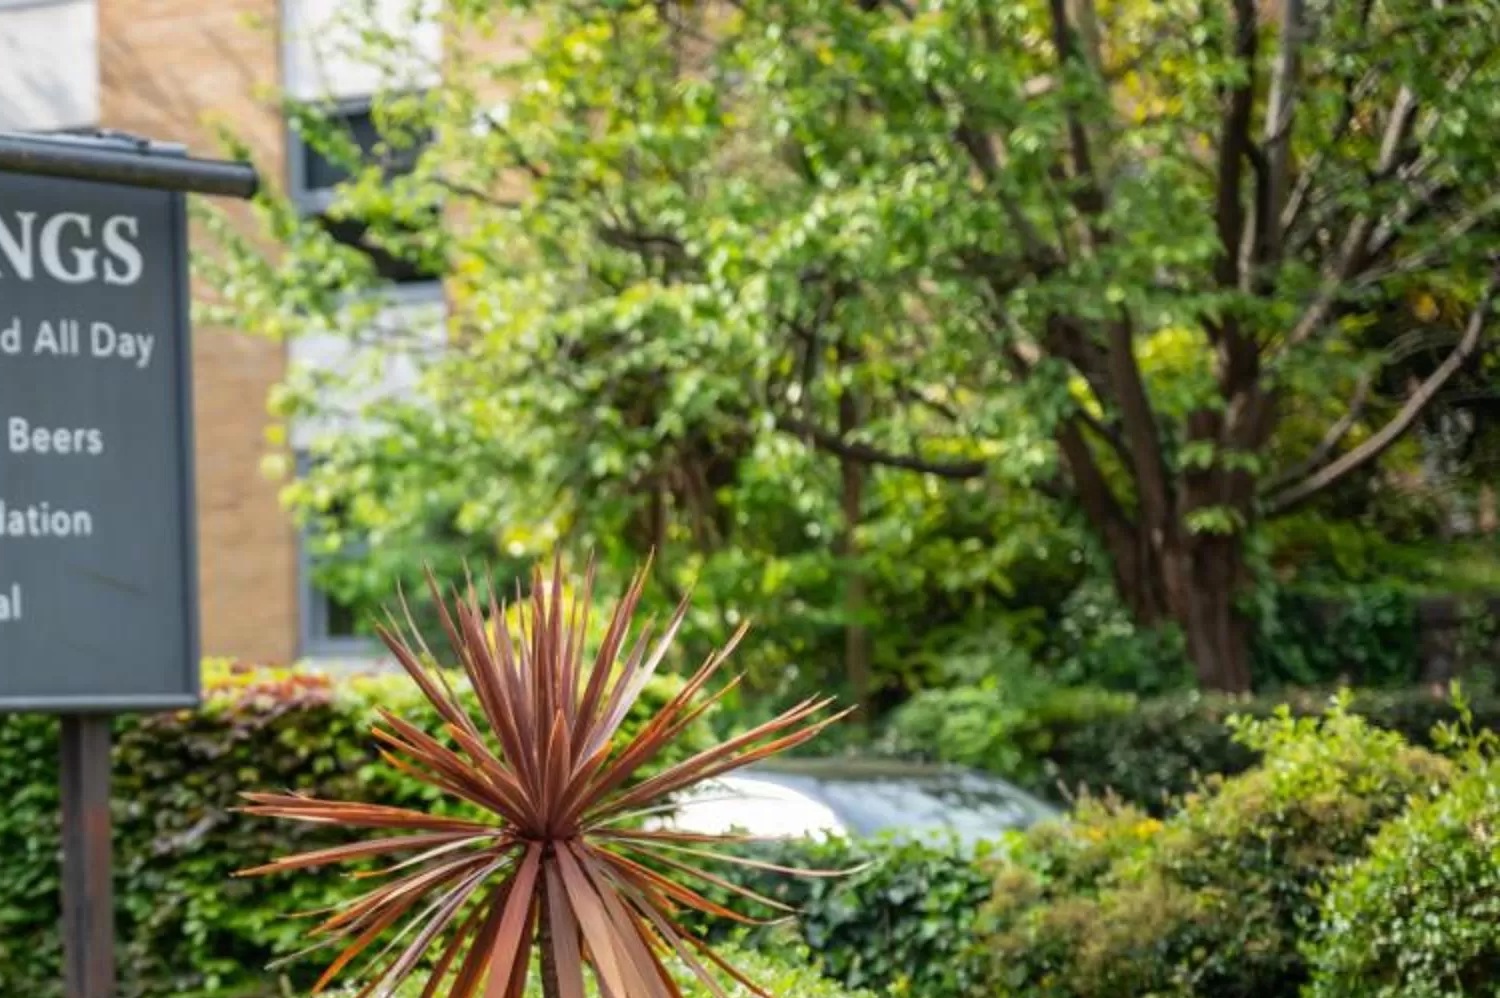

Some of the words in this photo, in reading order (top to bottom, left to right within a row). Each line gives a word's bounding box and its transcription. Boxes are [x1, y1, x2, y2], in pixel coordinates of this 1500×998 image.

[34, 320, 80, 355] All
[91, 322, 154, 367] Day
[8, 416, 103, 454] Beers
